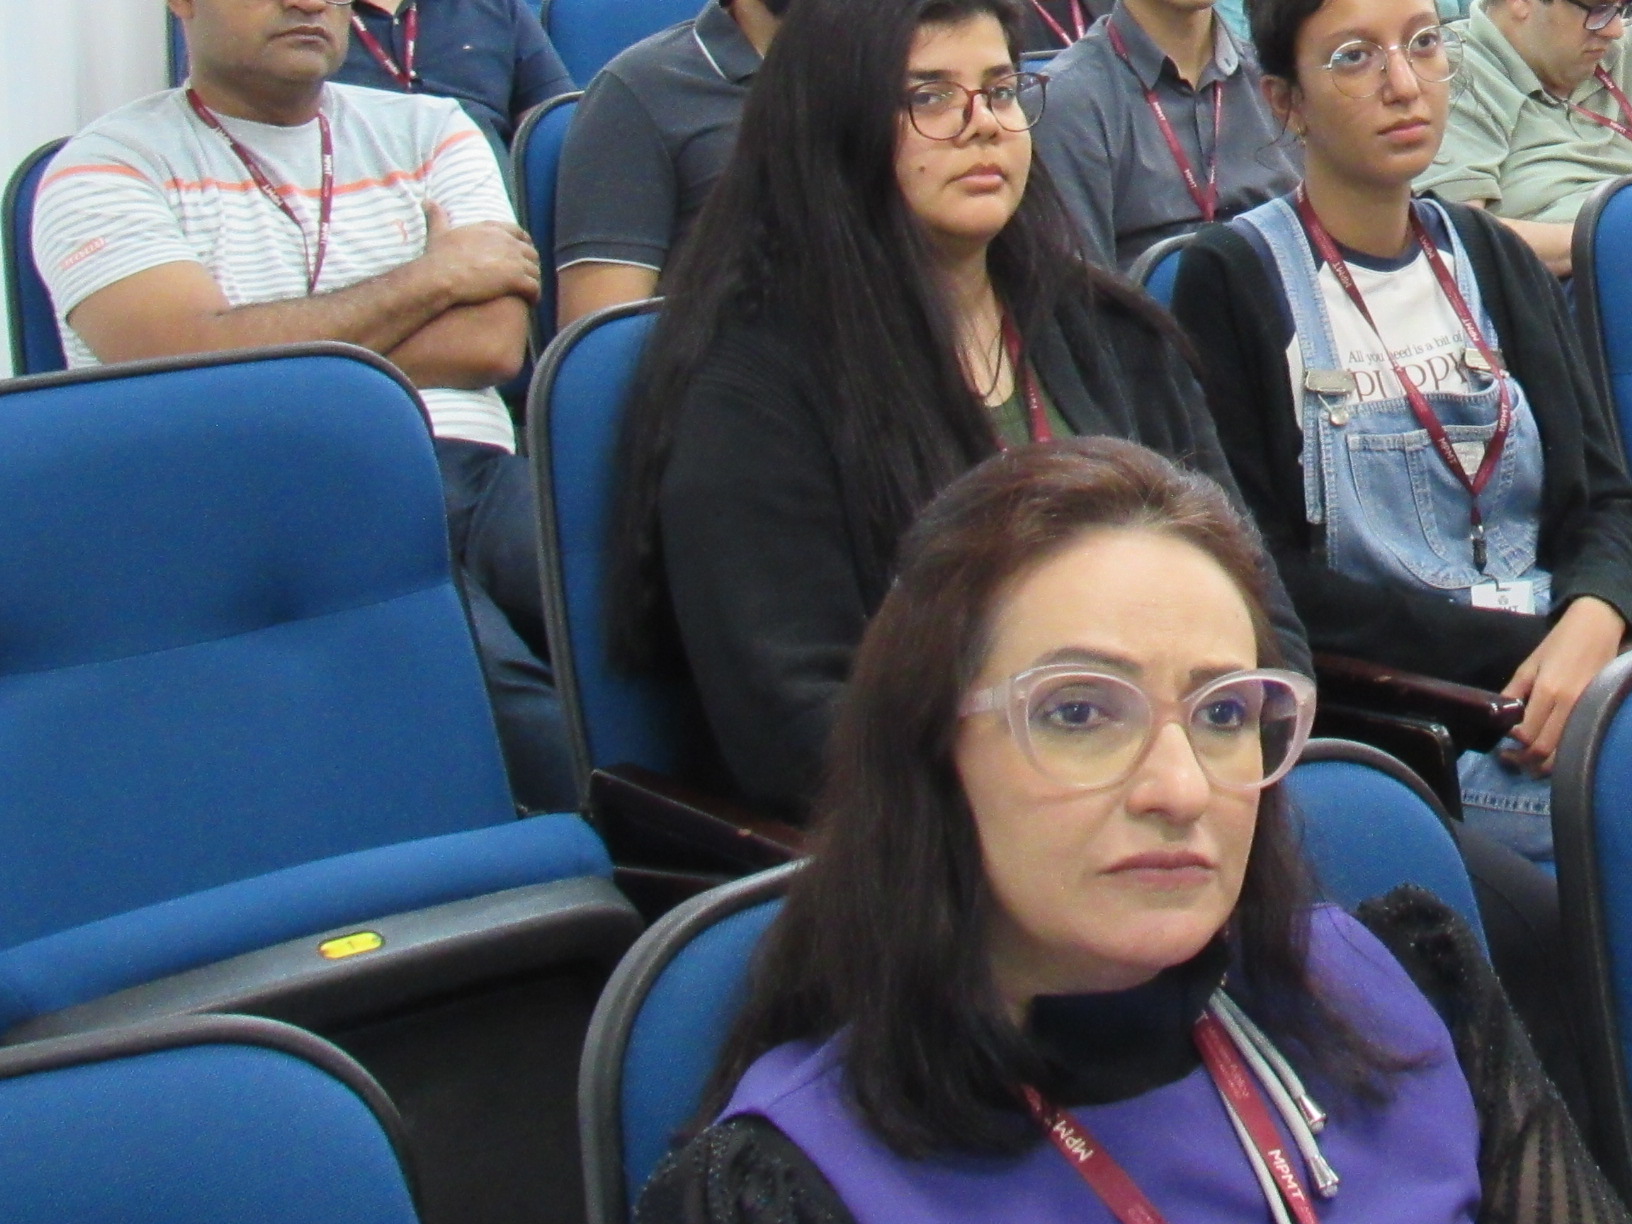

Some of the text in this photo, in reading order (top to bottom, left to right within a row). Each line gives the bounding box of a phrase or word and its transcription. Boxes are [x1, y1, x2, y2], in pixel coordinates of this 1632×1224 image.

[1420, 234, 1435, 259] MPMT
[1331, 261, 1352, 288] MPMT
[1462, 317, 1480, 342] MPMT
[1348, 349, 1365, 364] All
[1366, 352, 1384, 366] you
[1413, 344, 1424, 356] is
[1425, 343, 1433, 352] a
[1434, 334, 1451, 348] bit
[1500, 402, 1509, 432] MPMT
[1438, 437, 1458, 464] MPMT
[1268, 1149, 1305, 1201] MPMT
